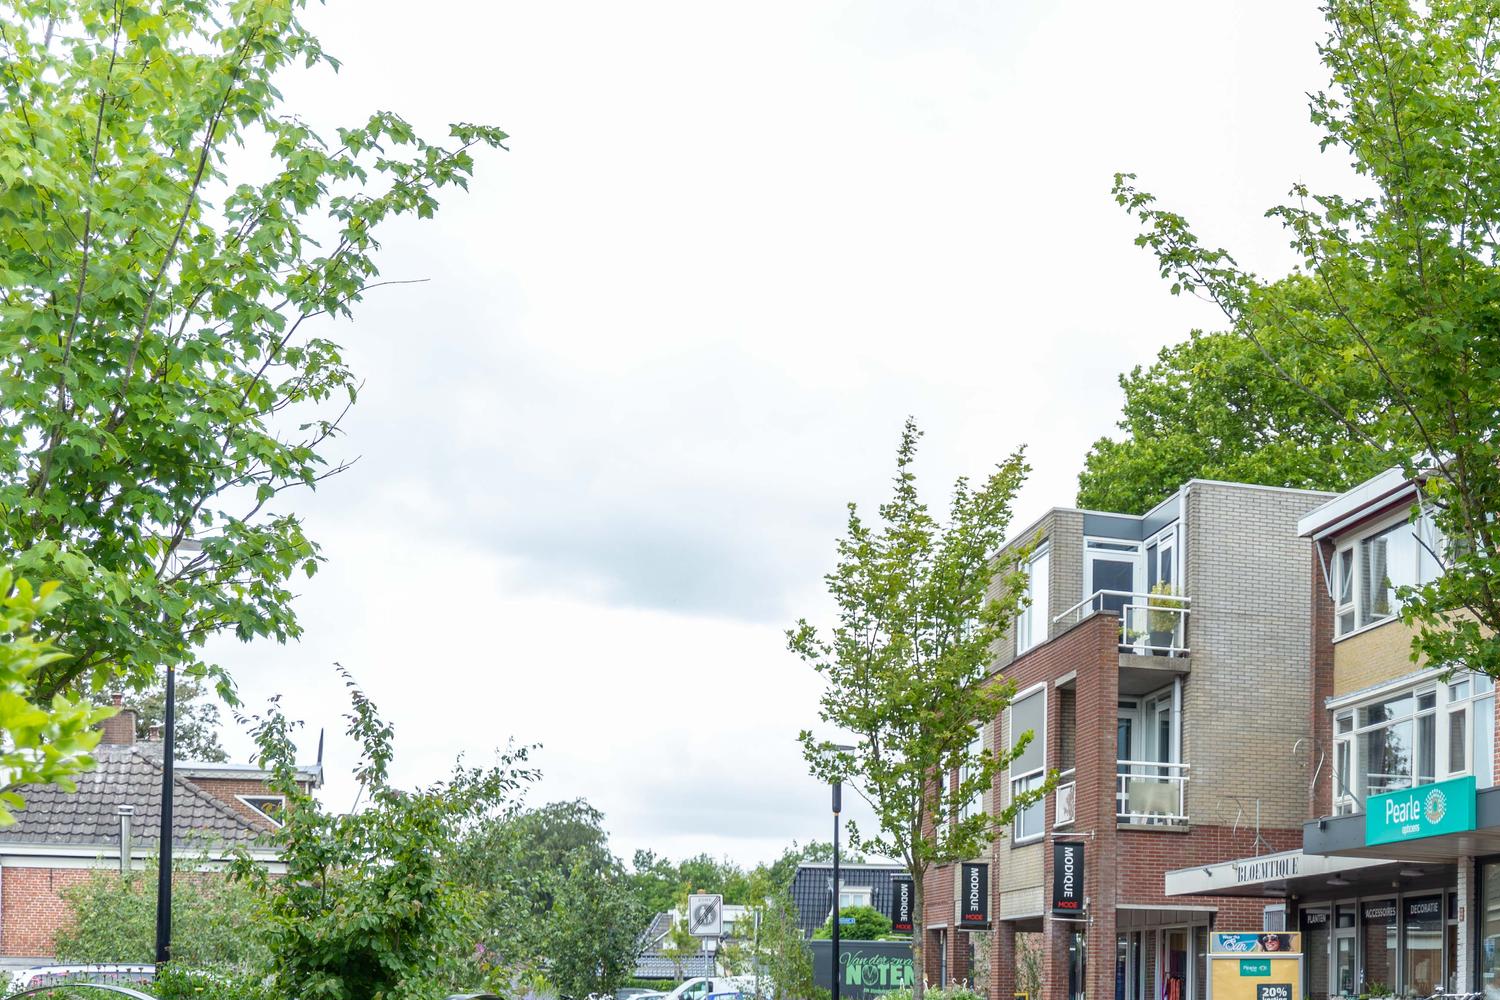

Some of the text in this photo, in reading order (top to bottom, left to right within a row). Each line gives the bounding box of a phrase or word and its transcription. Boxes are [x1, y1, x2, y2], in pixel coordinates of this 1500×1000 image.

[1385, 795, 1421, 825] Pearle
[1063, 846, 1075, 899] MODIQUE
[1237, 857, 1299, 884] BLOEMTIQUE
[970, 867, 979, 912] MODIQUE
[900, 883, 908, 922] MODIQUE
[1057, 901, 1079, 909] MODE
[1410, 902, 1439, 914] DECORATIE
[965, 913, 984, 921] MODE
[1307, 913, 1327, 924] PLANTEN
[1365, 906, 1397, 919] ACCESSOIRES
[840, 951, 868, 966] Van
[1262, 987, 1288, 997] 20%
